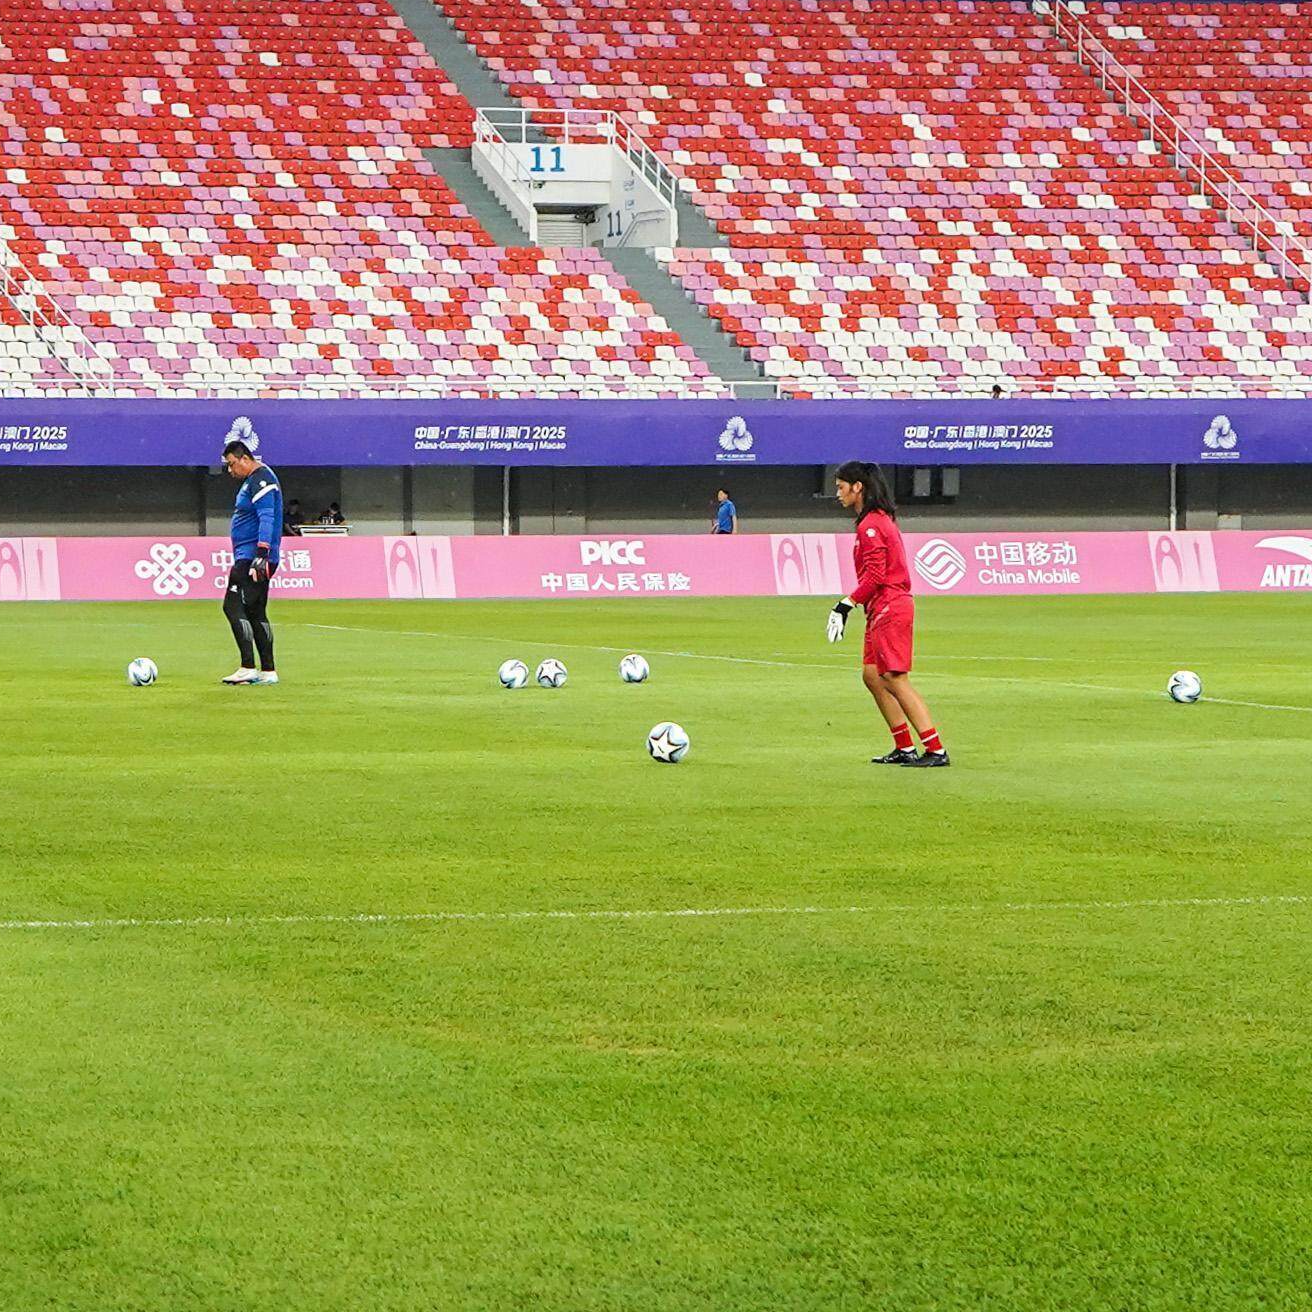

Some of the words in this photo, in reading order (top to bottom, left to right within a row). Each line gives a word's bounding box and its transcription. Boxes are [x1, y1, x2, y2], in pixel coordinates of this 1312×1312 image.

[528, 146, 566, 173] 11
[606, 211, 623, 238] 11
[32, 427, 67, 439] 2025
[532, 427, 567, 439] 2025
[1019, 426, 1053, 437] 2025
[13, 443, 34, 451] Kong
[489, 442, 512, 450] Hong
[513, 442, 534, 451] Kong
[580, 540, 646, 566] PICC
[974, 541, 1077, 566] 中国移动
[541, 572, 691, 592] 中国人民保险
[978, 569, 1025, 585] China
[1027, 569, 1080, 585] Mobile
